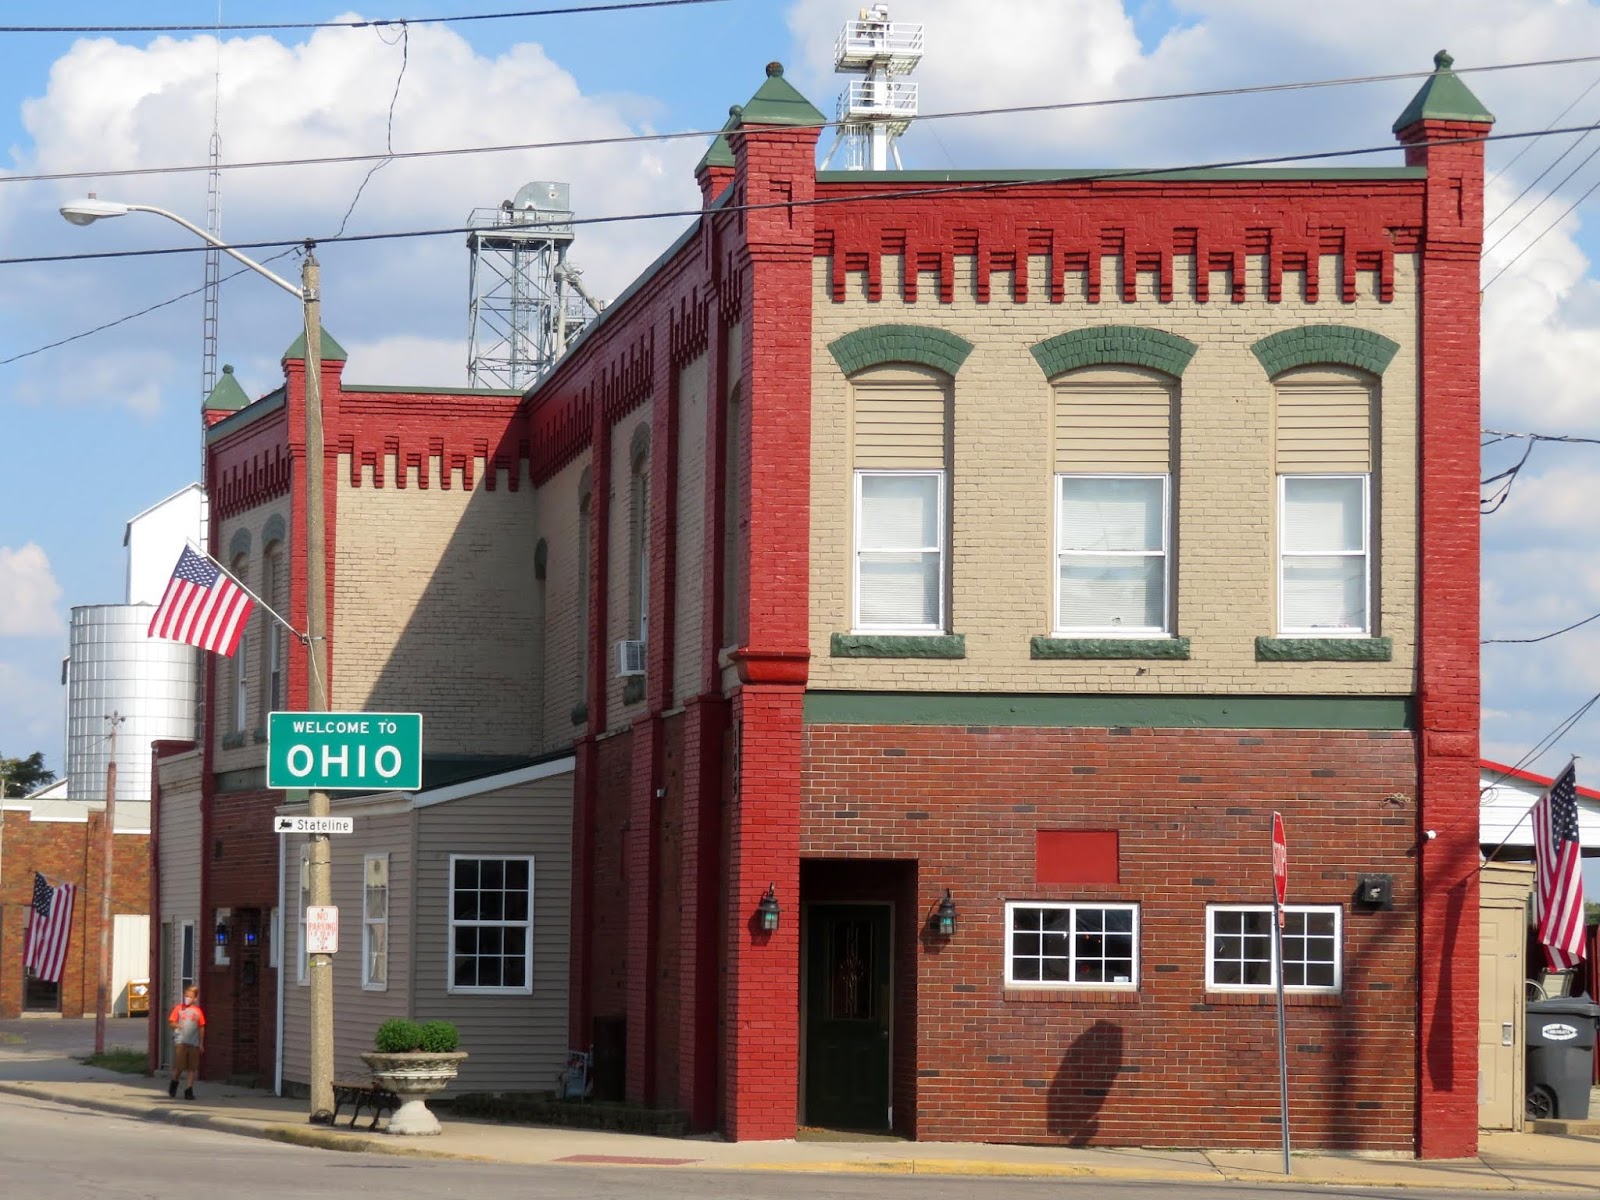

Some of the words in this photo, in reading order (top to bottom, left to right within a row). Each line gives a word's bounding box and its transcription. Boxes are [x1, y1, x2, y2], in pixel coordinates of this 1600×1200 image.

[293, 721, 370, 734] WELCOME
[378, 722, 397, 734] TO
[287, 744, 402, 778] OHIO
[297, 819, 349, 831] Stateline
[316, 911, 329, 920] NO
[309, 922, 336, 931] PARKING
